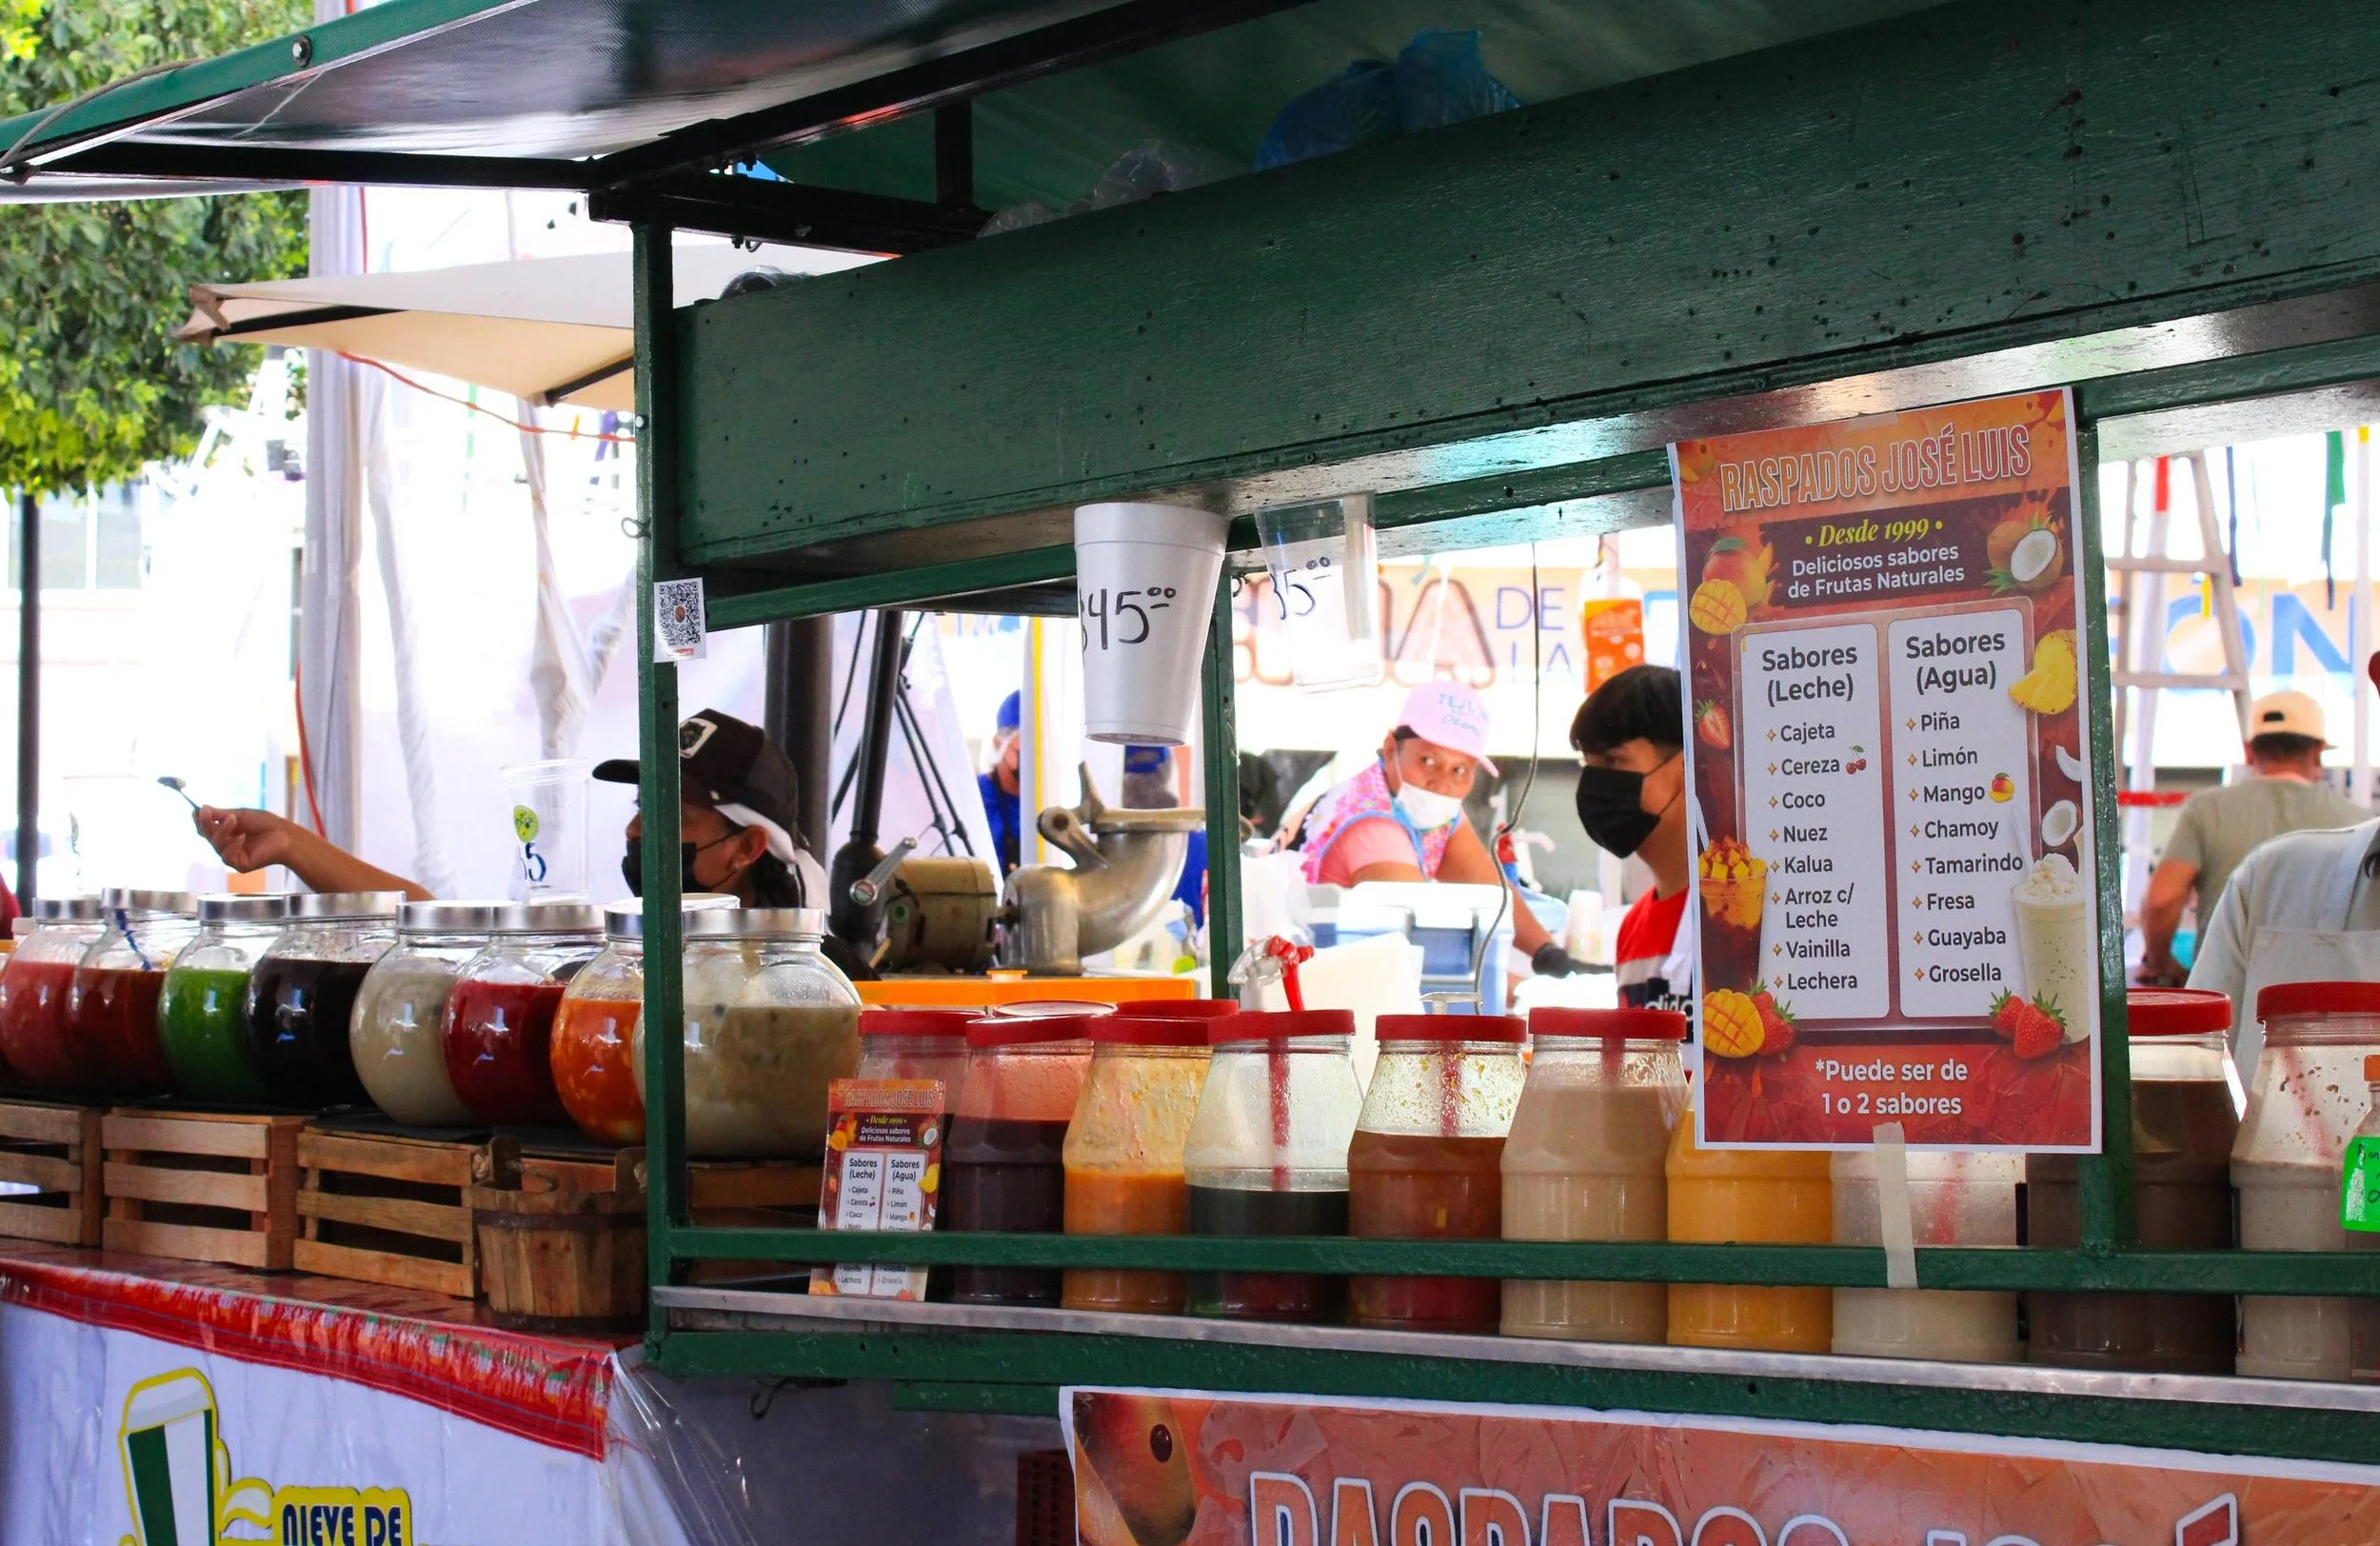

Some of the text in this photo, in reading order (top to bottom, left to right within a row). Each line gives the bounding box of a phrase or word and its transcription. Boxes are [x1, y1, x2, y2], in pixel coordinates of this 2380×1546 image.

[1720, 422, 2032, 512] RASPADOS JOSÉ LUIS
[1818, 518, 1930, 547] Desde 1999
[1792, 545, 1959, 577] Deliciosos sabores
[1788, 565, 1965, 599] de Frutas Naturales
[1497, 586, 1566, 631] DE
[1905, 632, 2006, 660] Sabores
[1762, 645, 1858, 672] Sabores
[1915, 661, 1996, 695] (Agua)
[1767, 673, 1854, 706] (Leche)
[1920, 712, 1961, 731] Piña
[1779, 723, 1835, 744] Cajeta
[1922, 746, 1978, 767] Limón
[1780, 758, 1840, 776] Cereza
[1782, 792, 1826, 809] Coco
[1923, 785, 1986, 805] Mango
[1783, 825, 1828, 843] Nuez
[1924, 820, 1999, 840] Chamoy
[1784, 855, 1834, 874] Kalua
[1925, 852, 2024, 875] Tamarindo
[1784, 882, 1854, 905] Arroz c/
[1927, 893, 1974, 911] Fresa
[1786, 911, 1838, 929] Leche
[1928, 927, 2006, 950] Guayaba
[1786, 940, 1851, 959] Vainilla
[1787, 970, 1858, 991] Lechera
[1929, 963, 2002, 982] Grosella
[1901, 1062, 1934, 1081] ser
[1940, 1058, 1968, 1081] de
[1821, 1092, 1962, 1115] 1 o 2 sabores
[885, 1135, 911, 1143] Naturales
[849, 1158, 878, 1168] Sabores
[890, 1159, 920, 1169] Sabores
[849, 1170, 876, 1181] (Leche)
[892, 1171, 917, 1182] (Agua)
[851, 1186, 868, 1196] Cajeta
[849, 1210, 863, 1219] Coco
[889, 1214, 908, 1222] Mango
[282, 1503, 402, 1546] NIEVE DE
